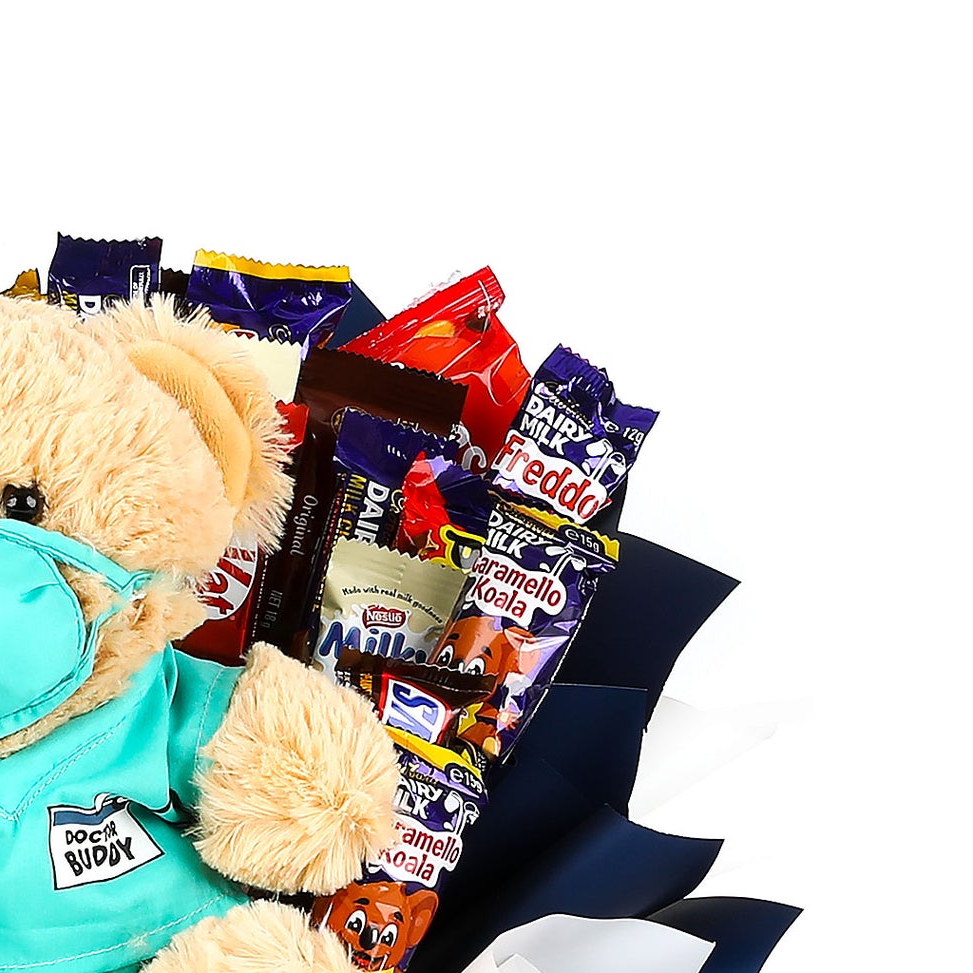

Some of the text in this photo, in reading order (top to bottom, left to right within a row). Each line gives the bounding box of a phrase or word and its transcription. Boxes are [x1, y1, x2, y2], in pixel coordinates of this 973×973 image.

[519, 414, 567, 456] MILK
[525, 394, 593, 443] DAIRY
[622, 427, 645, 446] 12g
[495, 434, 600, 520] Freddo
[290, 494, 319, 556] Original
[353, 480, 391, 545] DAIR
[488, 509, 554, 546] DAIRY
[579, 533, 601, 553] 15g
[363, 585, 380, 594] with
[380, 588, 397, 598] real
[396, 593, 413, 603] milk
[412, 600, 443, 624] goodness
[470, 576, 527, 618] Koala
[393, 788, 430, 820] ILK
[65, 820, 118, 845] DOCTOR
[65, 836, 135, 876] BUDDY
